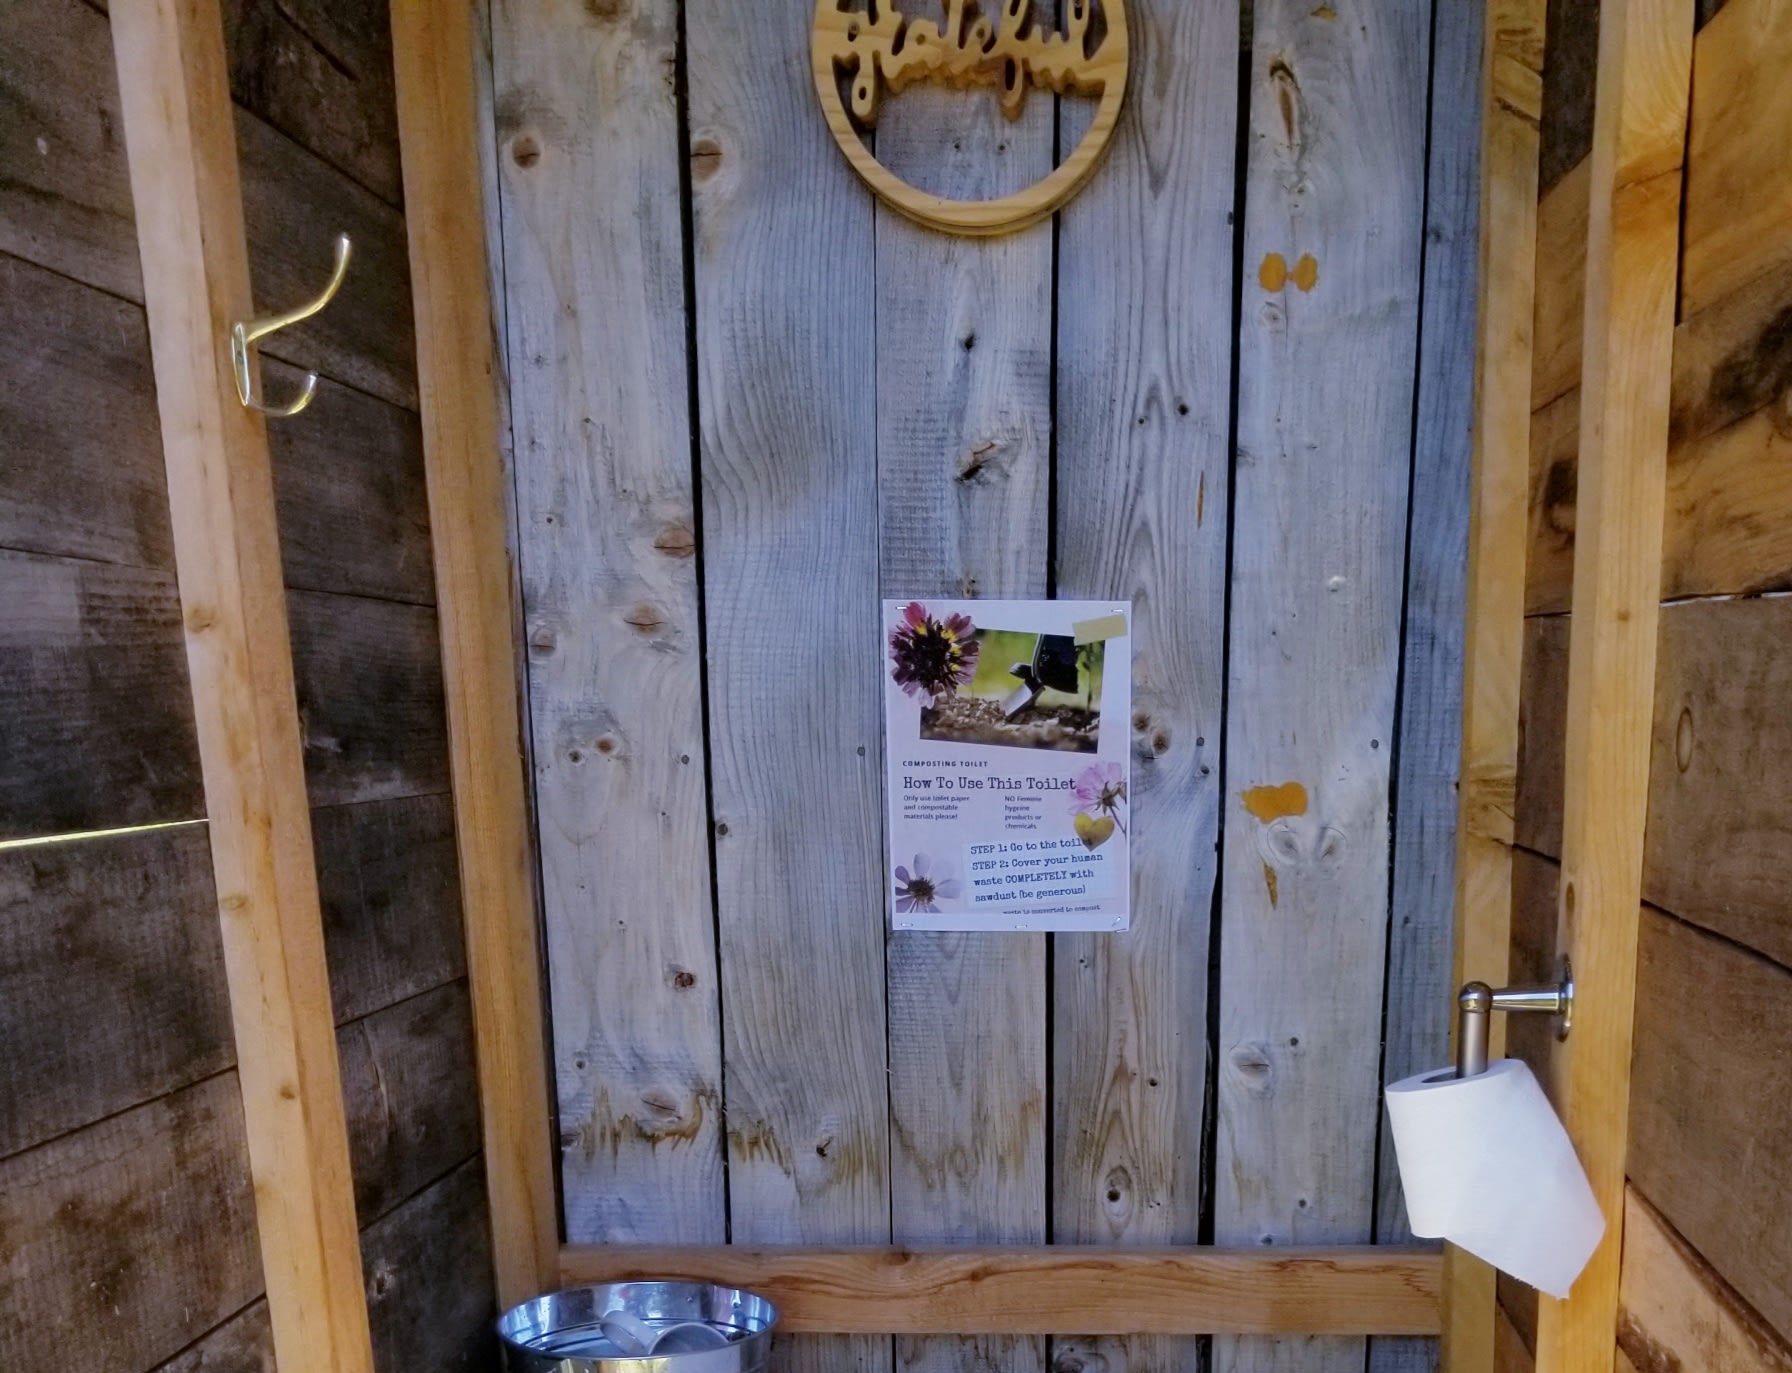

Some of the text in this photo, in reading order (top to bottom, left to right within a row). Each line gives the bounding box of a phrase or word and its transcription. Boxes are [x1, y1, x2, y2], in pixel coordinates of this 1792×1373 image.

[903, 776, 1077, 790] How To Use This Toilet
[917, 804, 958, 812] compostable
[935, 813, 958, 821] please!
[970, 845, 995, 855] STEP
[998, 843, 1008, 852] 1:
[1010, 842, 1023, 852] Go
[1026, 841, 1037, 850] to
[1040, 839, 1057, 849] the
[972, 853, 1103, 871] STEP 2: Cover your human
[973, 868, 1094, 886] waste COMPLETELY with
[975, 890, 1017, 902] sawdust
[1019, 889, 1034, 899] (be
